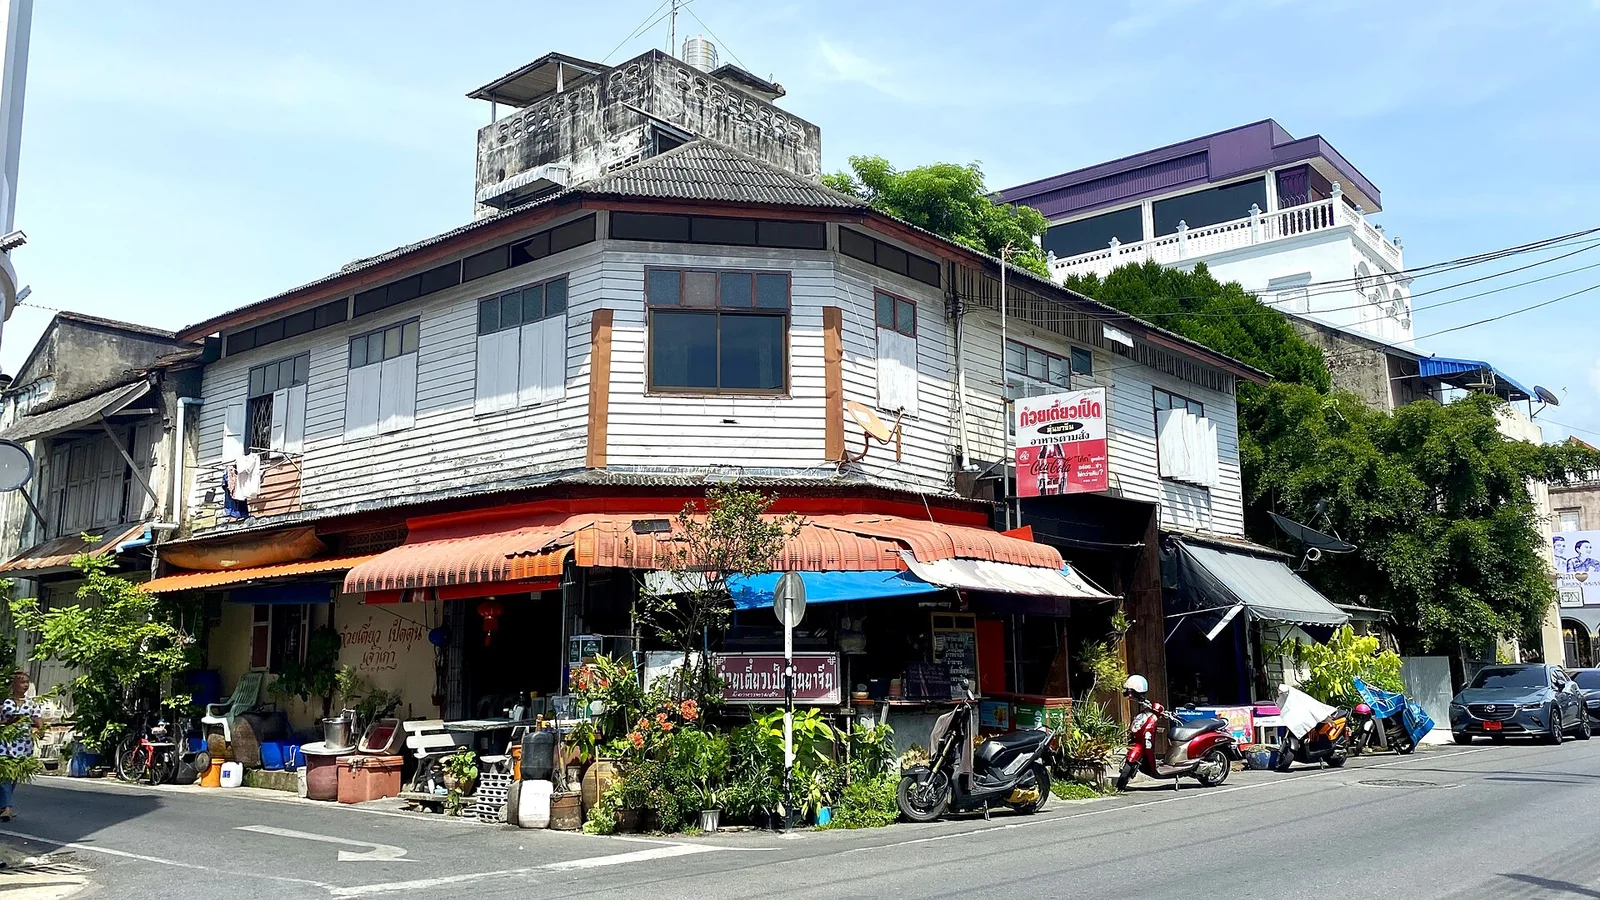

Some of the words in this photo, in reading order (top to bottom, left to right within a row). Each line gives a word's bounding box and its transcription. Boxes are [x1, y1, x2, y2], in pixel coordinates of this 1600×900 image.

[1020, 399, 1102, 427] ก๋วยเตี๋ยวเป็ด
[1030, 430, 1090, 446] อาหารตามสั่ง
[1030, 457, 1073, 475] Coca-Cola
[340, 616, 382, 648] ก๋วยเตี๋ยว
[363, 644, 396, 666] เจ้าเก่า
